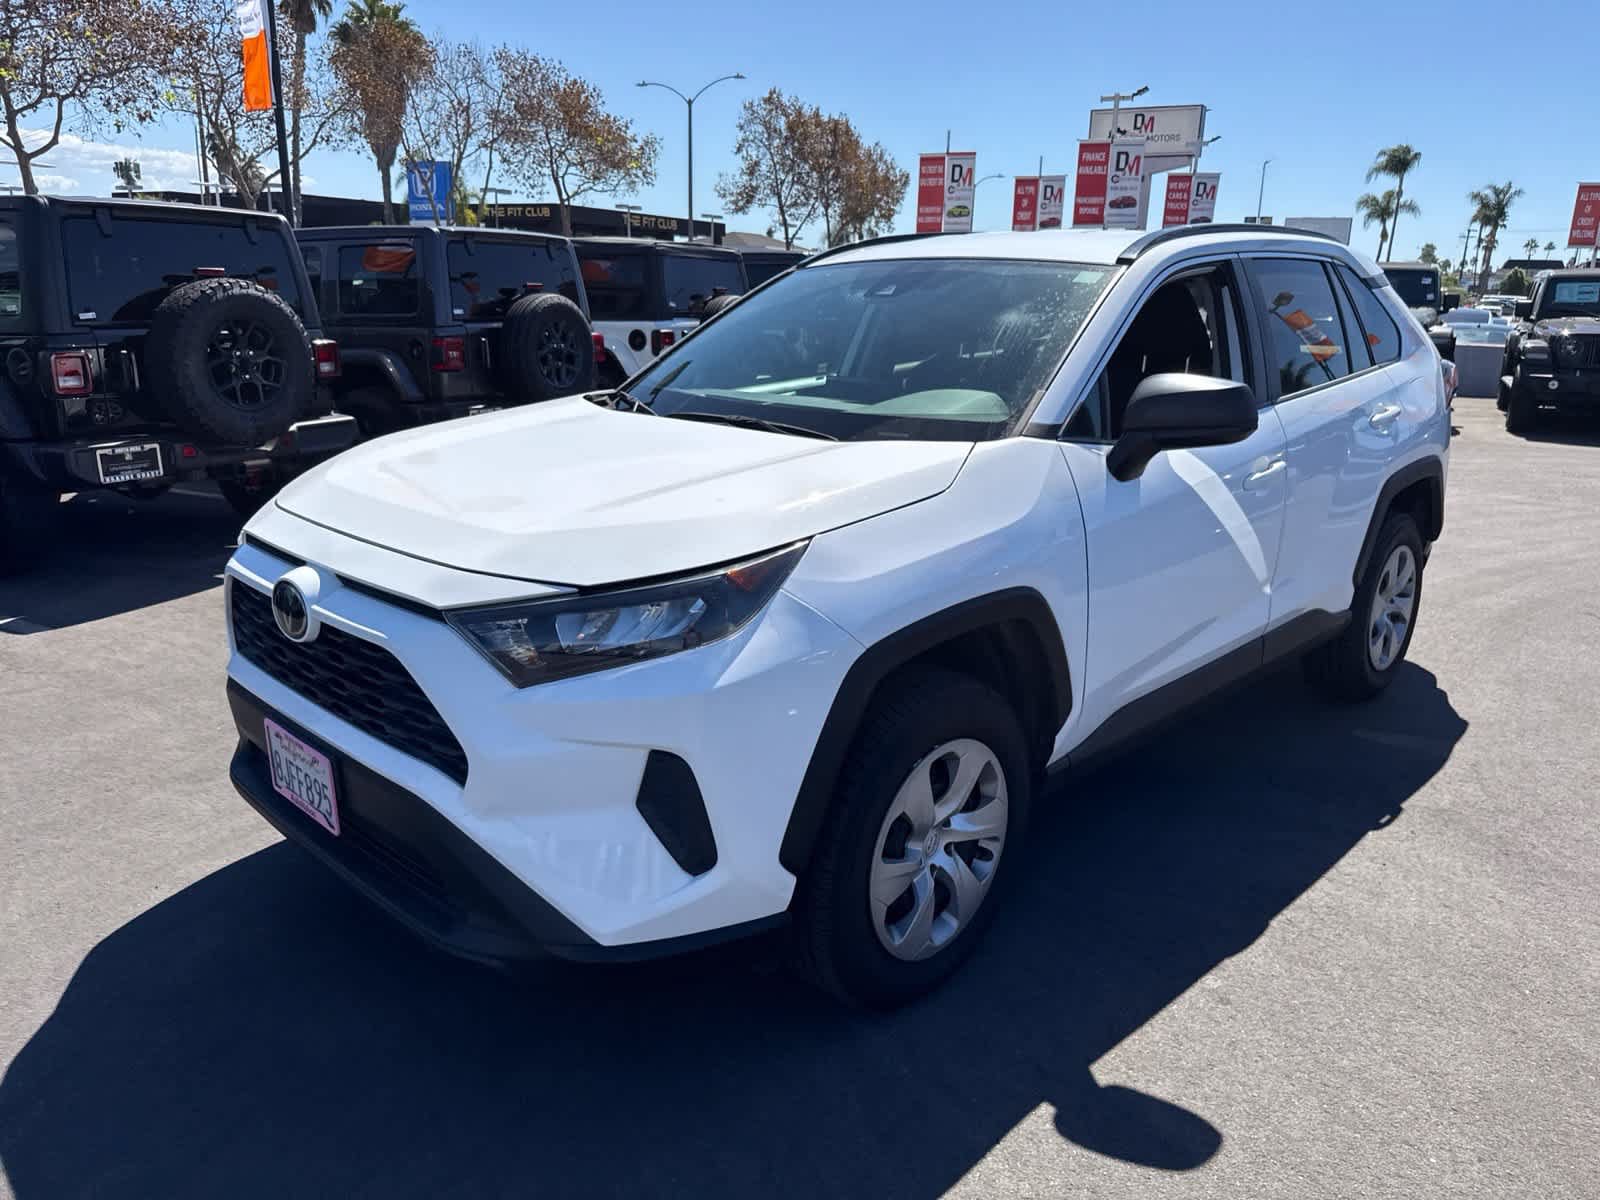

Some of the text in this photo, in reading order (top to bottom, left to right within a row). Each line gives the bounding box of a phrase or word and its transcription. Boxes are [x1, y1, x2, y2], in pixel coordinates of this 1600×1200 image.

[507, 207, 523, 217] FIT
[524, 208, 551, 218] CLUB
[642, 217, 656, 229] FIT
[657, 218, 679, 231] CLUB
[274, 750, 333, 819] 8JFF895
